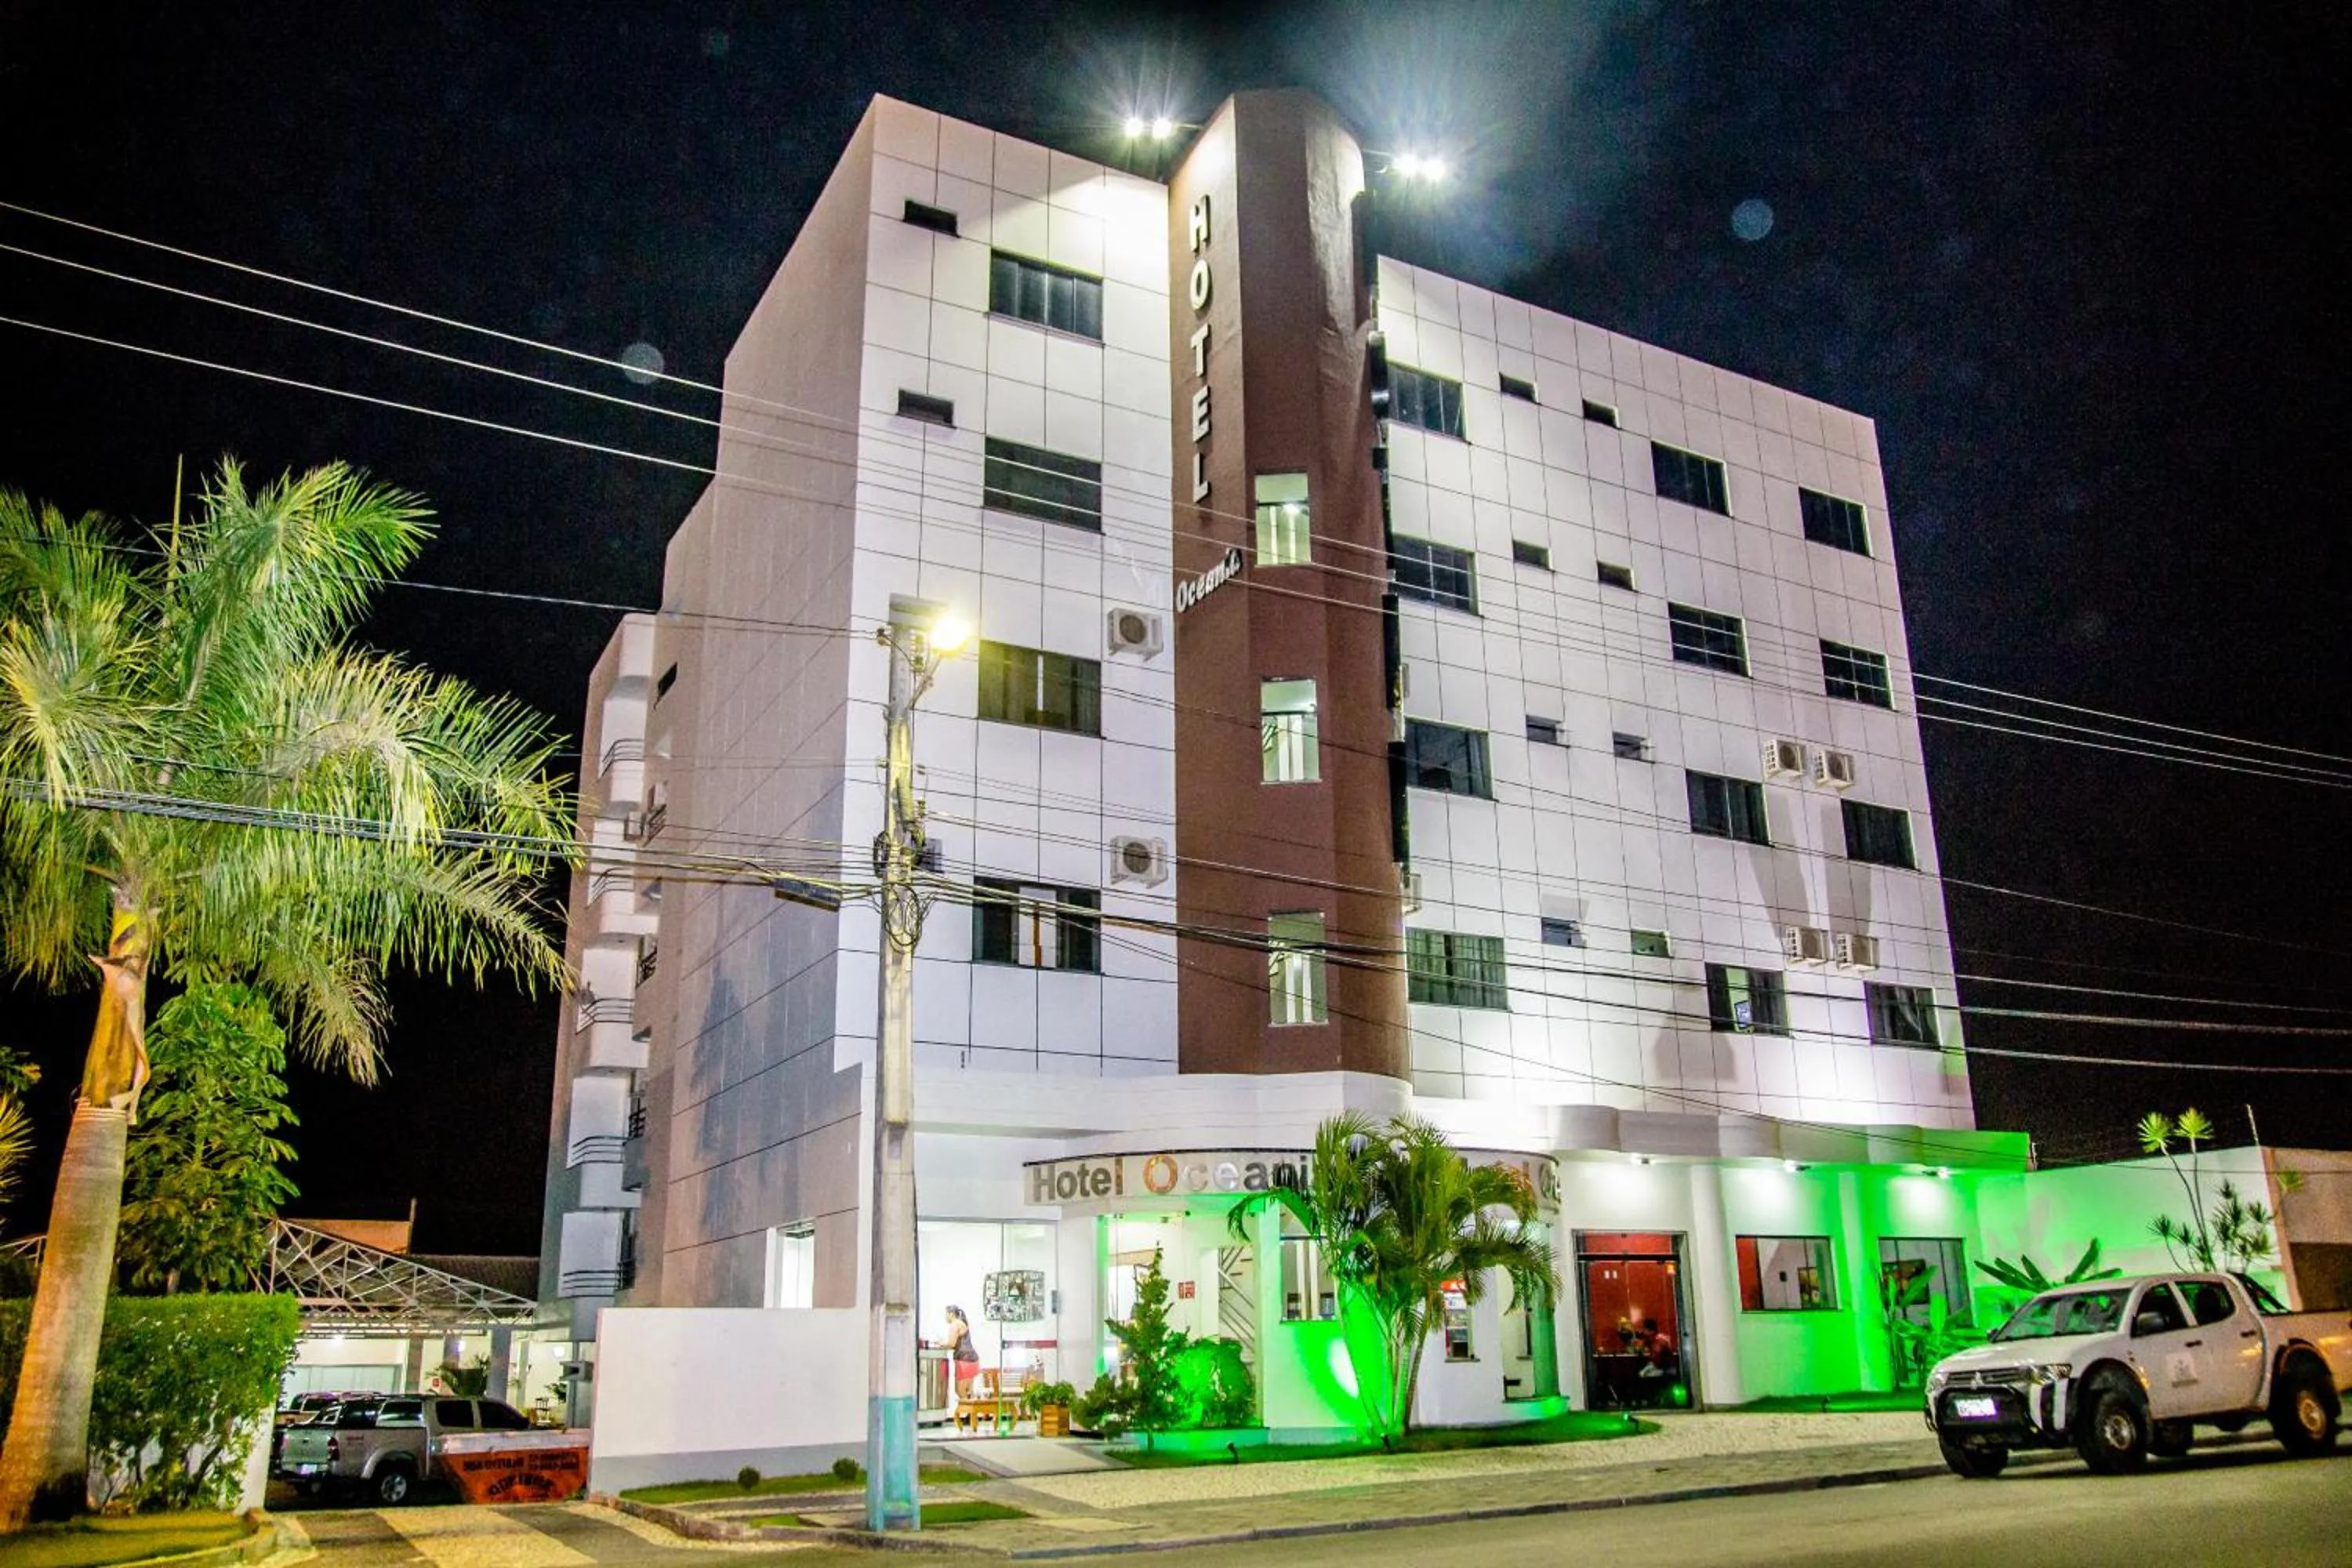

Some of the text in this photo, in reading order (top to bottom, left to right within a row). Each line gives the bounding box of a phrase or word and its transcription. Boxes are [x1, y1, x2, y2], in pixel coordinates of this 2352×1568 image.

[1189, 194, 1211, 503] HOTEL
[1032, 1154, 1310, 1203] Hotel Oceani
